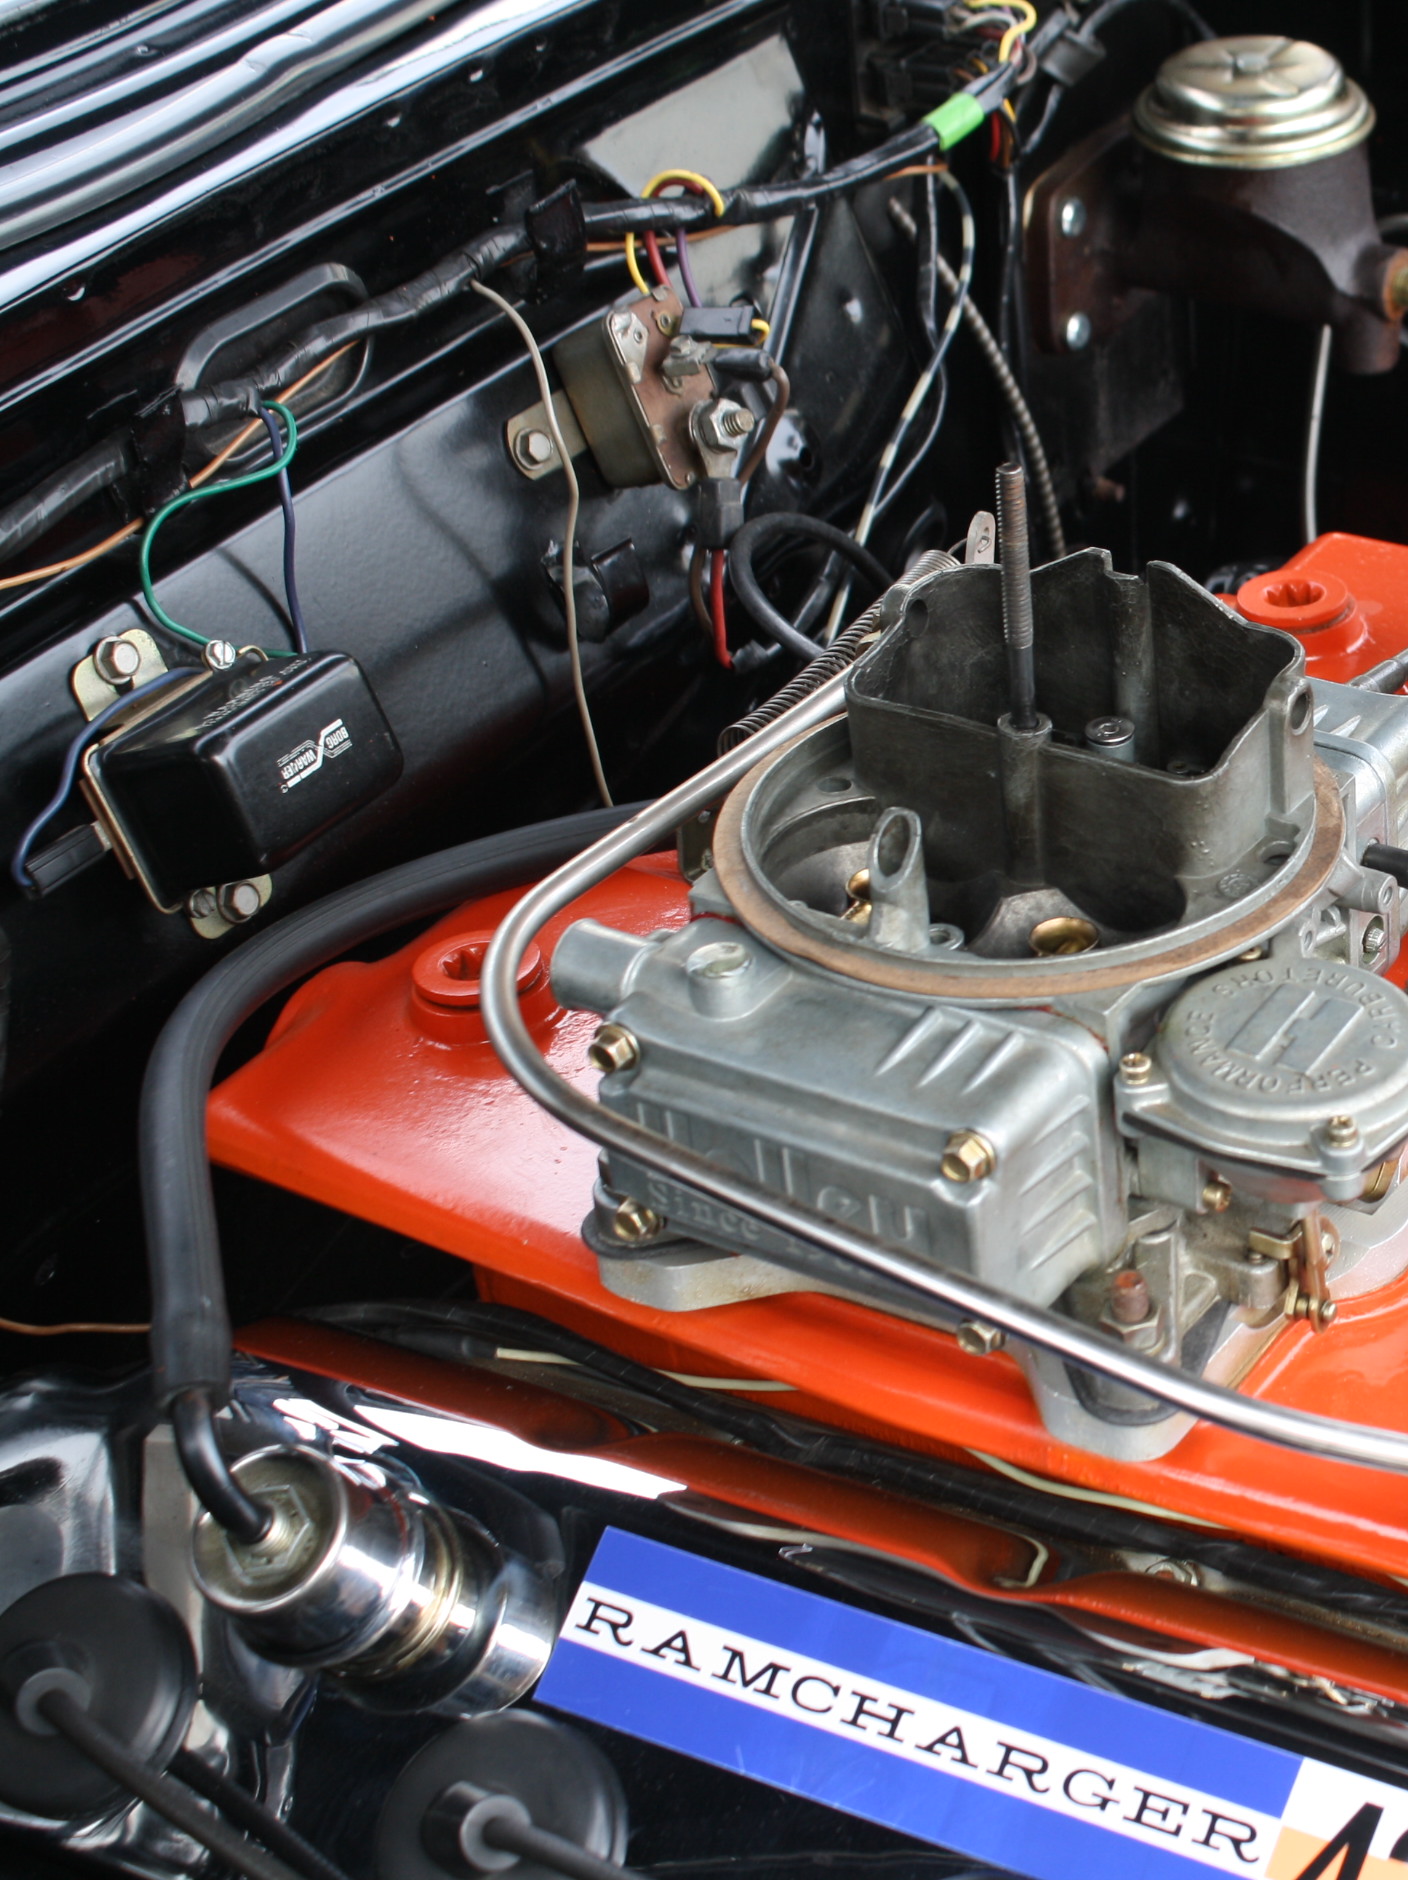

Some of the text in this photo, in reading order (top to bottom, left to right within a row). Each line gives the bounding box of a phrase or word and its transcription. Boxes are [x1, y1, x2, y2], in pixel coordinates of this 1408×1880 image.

[280, 726, 349, 780] BORG WARNER
[1211, 965, 1399, 1049] CARBURETORS
[1184, 1009, 1377, 1096] PERFORMANCE
[574, 1596, 1262, 1866] RAMCHARGER
